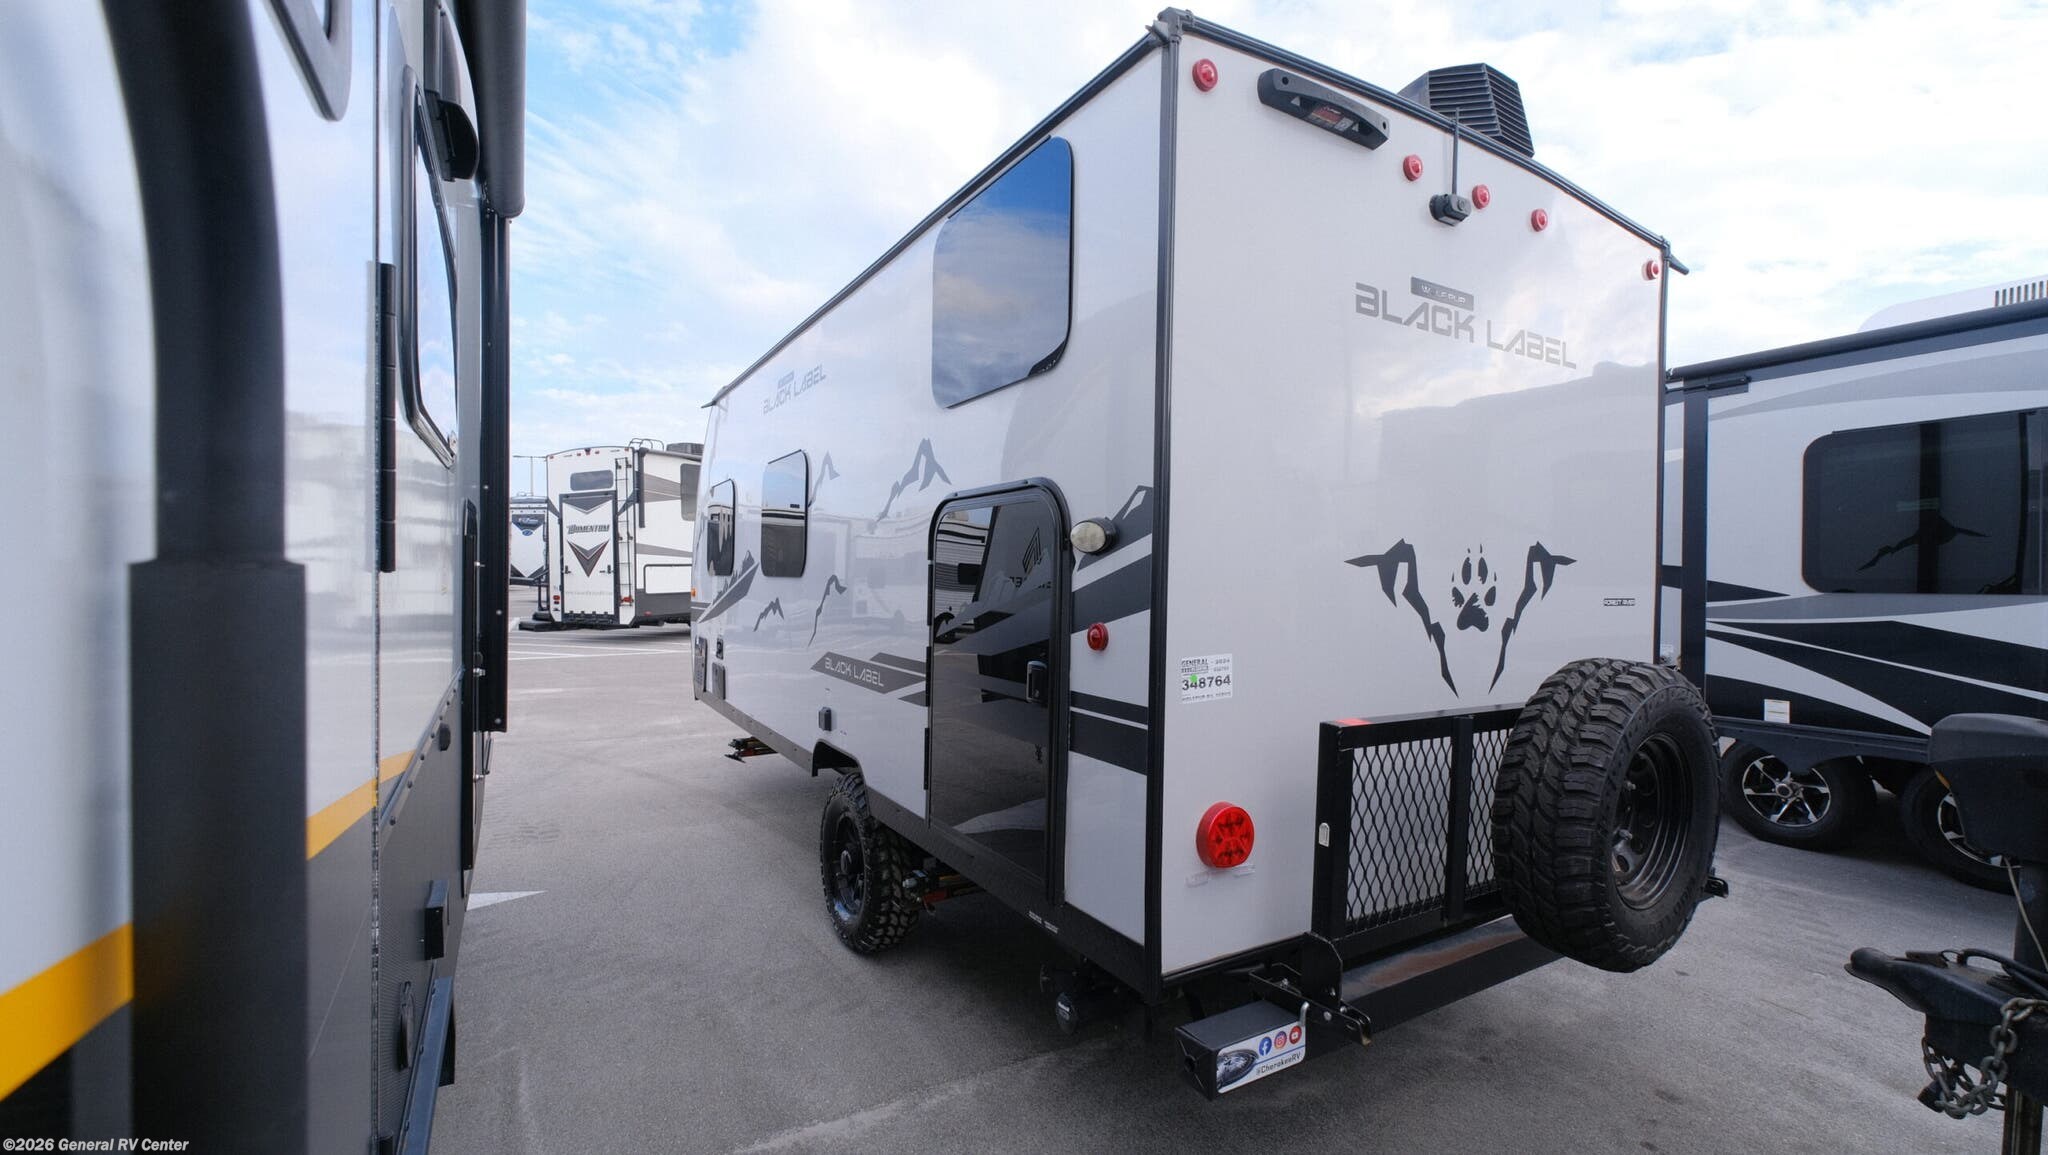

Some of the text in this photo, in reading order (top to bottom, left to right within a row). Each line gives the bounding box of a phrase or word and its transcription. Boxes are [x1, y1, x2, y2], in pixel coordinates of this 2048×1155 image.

[1355, 282, 1576, 370] BLACK LABEL
[762, 384, 792, 414] BLACK
[794, 364, 826, 397] LABEL
[825, 657, 884, 687] BLACK LABEL
[1182, 675, 1231, 690] 348764
